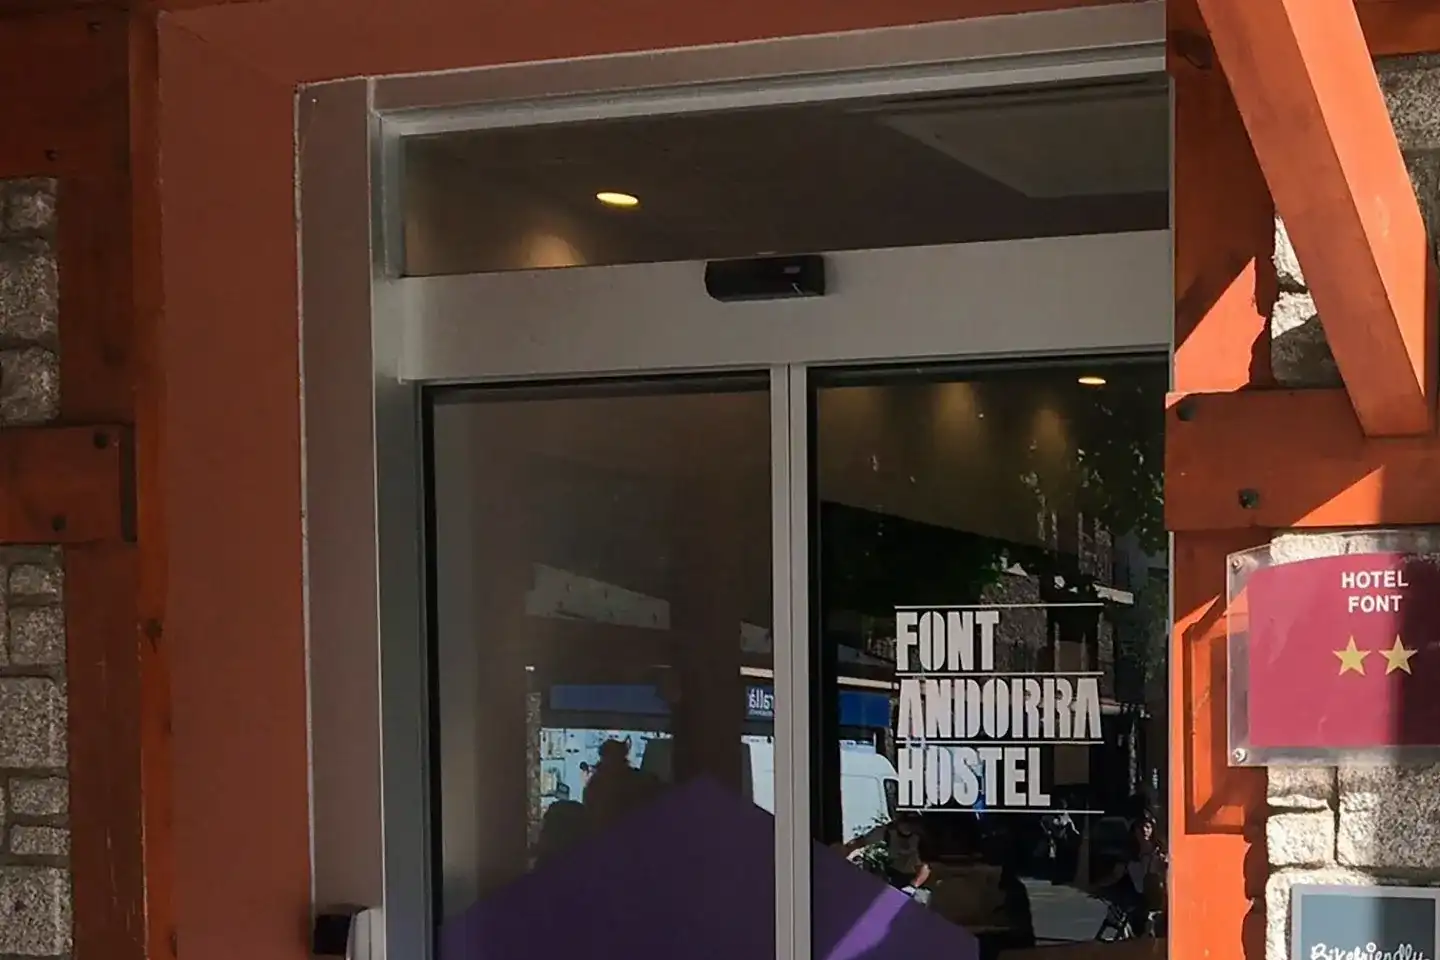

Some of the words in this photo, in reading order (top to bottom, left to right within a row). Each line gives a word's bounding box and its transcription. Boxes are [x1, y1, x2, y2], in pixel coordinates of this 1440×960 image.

[1340, 570, 1409, 589] HOTEL
[1347, 595, 1403, 613] FONT
[896, 610, 999, 671] FONT
[897, 677, 1102, 739] ANDORRA
[897, 746, 1051, 807] HOSTEL
